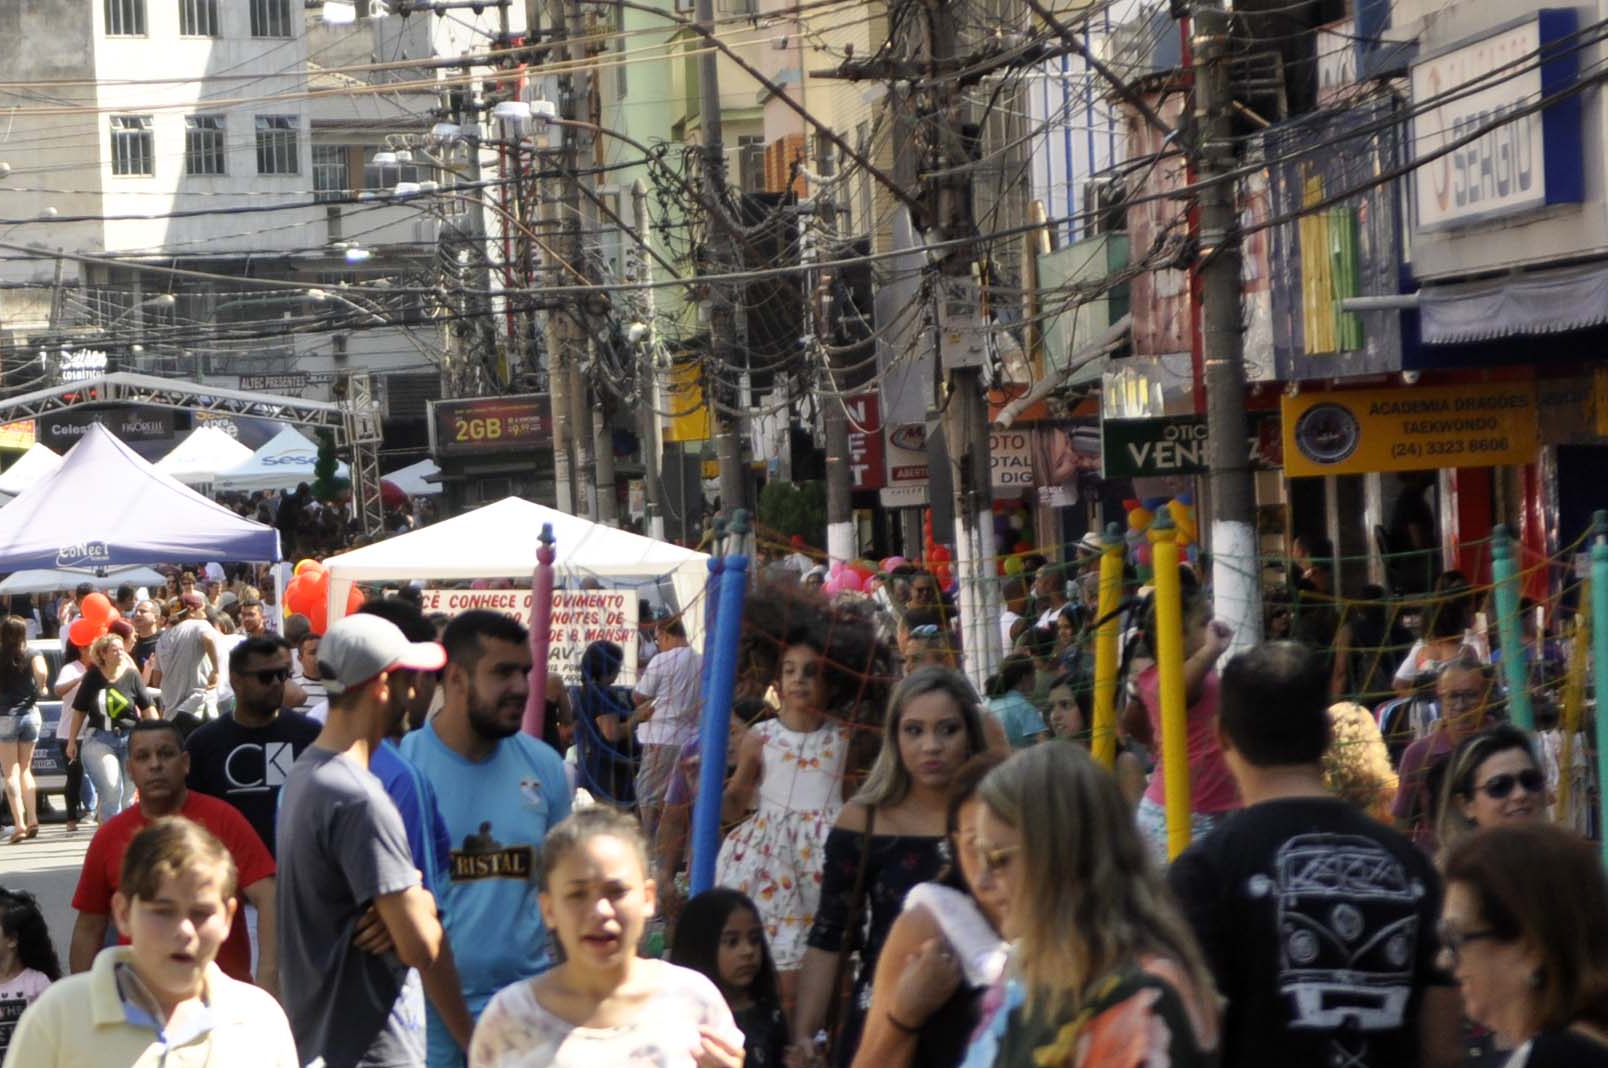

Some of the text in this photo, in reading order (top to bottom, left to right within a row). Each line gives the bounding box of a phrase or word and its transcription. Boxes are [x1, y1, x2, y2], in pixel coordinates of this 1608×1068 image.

[1453, 96, 1532, 208] SERGIO
[455, 418, 501, 441] 2GB
[1402, 418, 1497, 434] TAEKWONDO
[988, 434, 1025, 450] OTO
[990, 455, 1032, 469] OTAL
[423, 590, 441, 609] CÊ
[449, 594, 517, 609] CONHECE
[552, 594, 625, 609] OVIMENTO
[551, 611, 625, 625] NOITES DE
[225, 742, 294, 788] CK
[450, 852, 526, 876] RISTAL
